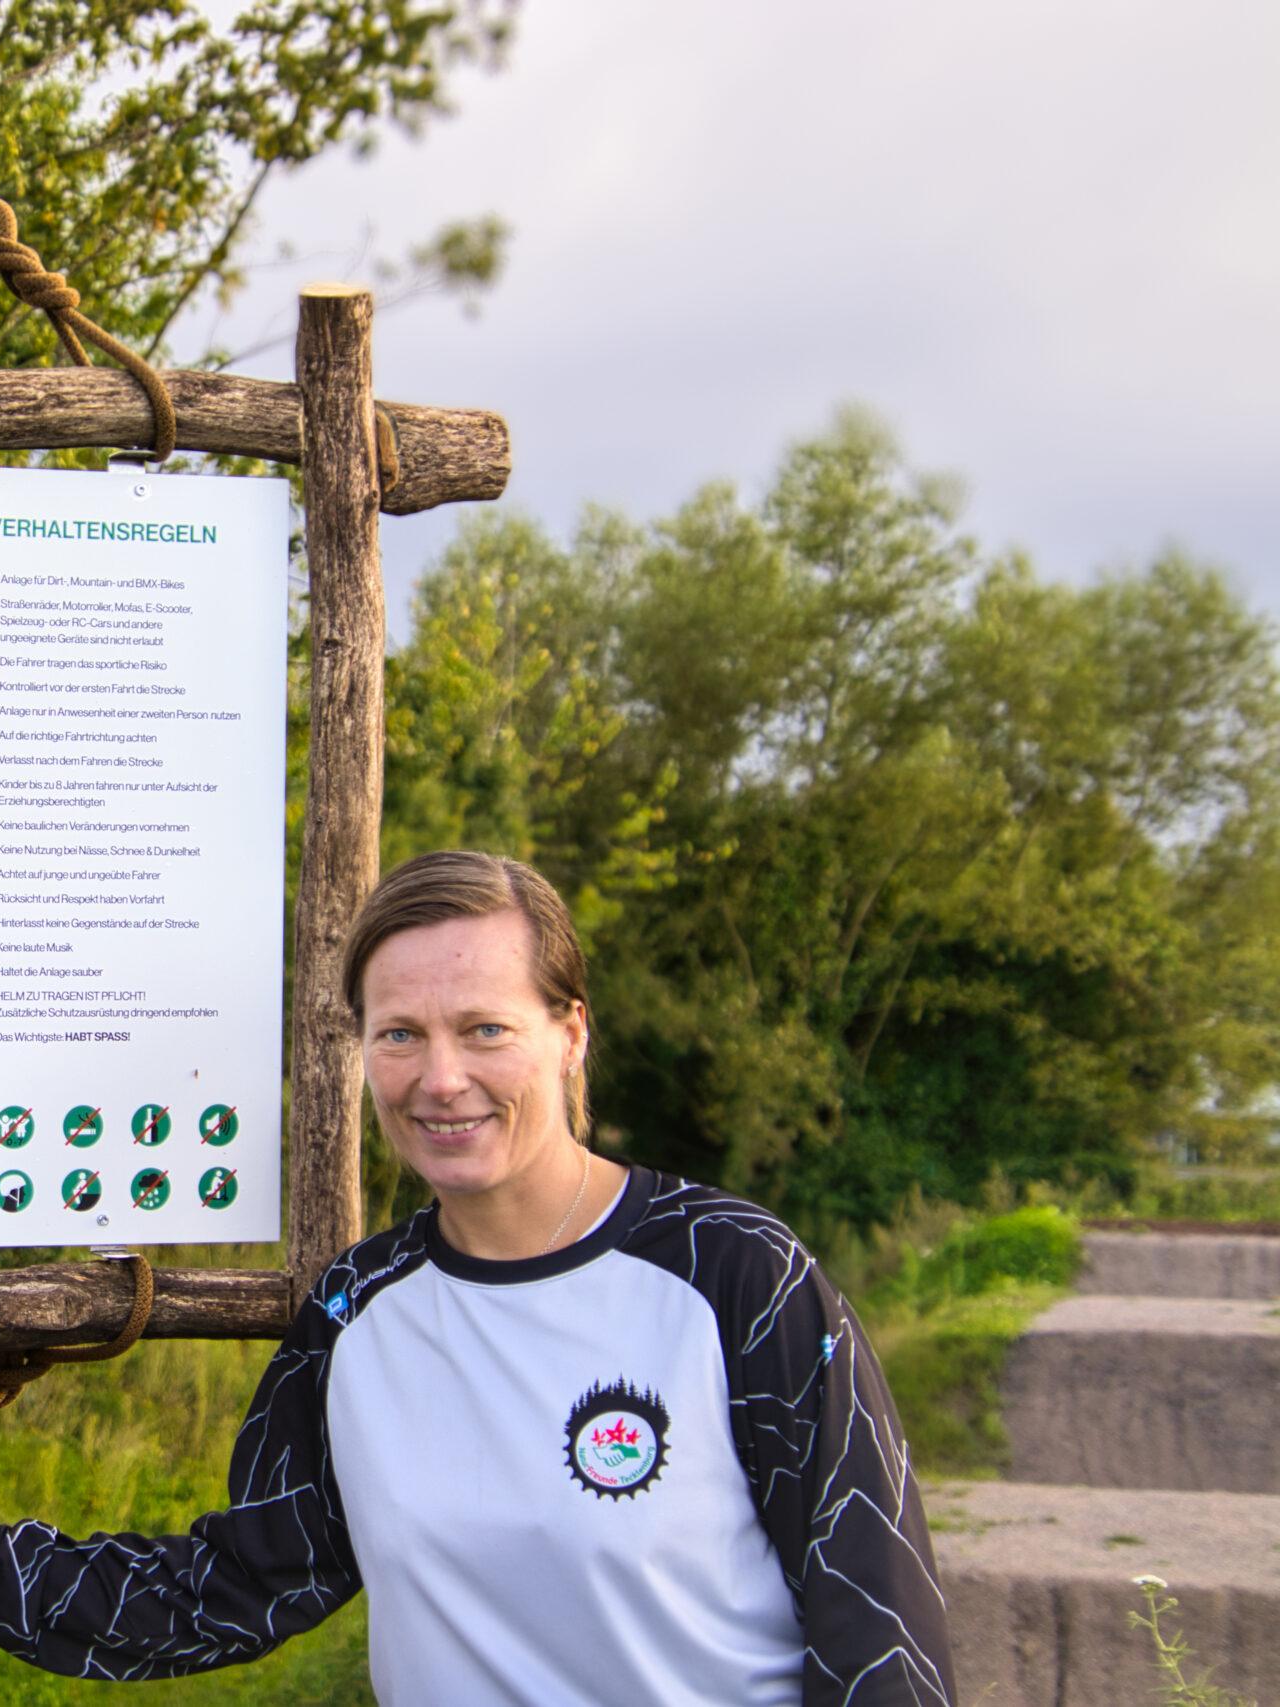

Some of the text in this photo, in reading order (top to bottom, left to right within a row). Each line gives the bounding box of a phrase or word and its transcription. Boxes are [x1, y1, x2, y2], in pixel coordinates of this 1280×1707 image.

[1, 573, 32, 588] Anlage
[34, 574, 46, 586] für
[70, 576, 115, 588] Mountain-
[117, 577, 134, 589] und
[136, 577, 185, 591] BMX-Bikes
[0, 598, 193, 616] Straßenräder, Motorroller, Mofas, E-Scooter,
[0, 614, 162, 630] Spielzeug- oder RC-Cars und andere
[0, 632, 163, 647] ungeeignete Geräte sind nicht erlaubt
[0, 656, 167, 672] Die Fahrer tragen das sportliche Risiko
[0, 680, 186, 696] Kontrolliert der ersten Fahrt die Strecke
[0, 705, 240, 721] Anlage Anwesenheit einer zweiten Person nutzen
[0, 729, 157, 745] Auf die richtige Fahrtrichtung achten
[0, 754, 163, 768] Verlasst nach dem Fahren die Strecke
[0, 778, 27, 790] Kinder
[30, 779, 43, 790] bis
[63, 779, 94, 791] Jahren
[96, 780, 124, 792] fahren
[125, 783, 140, 792] nur
[141, 781, 164, 792] unter
[166, 781, 201, 793] Aufsicht
[203, 782, 217, 793] der
[25, 820, 67, 832] baulichen
[69, 820, 138, 834] Veränderungen
[140, 822, 189, 833] vornehmen
[25, 844, 62, 857] Nutzung
[64, 845, 77, 856] bei
[79, 845, 109, 857] Nässe,
[111, 845, 144, 857] Schnee
[154, 845, 200, 857] Dunkelheit
[28, 869, 43, 880] auf
[43, 869, 68, 882] junge
[70, 869, 87, 880] und
[89, 869, 130, 882] ungeübte
[132, 869, 160, 881] Fahrer
[43, 893, 60, 904] und
[61, 893, 98, 906] Respekt
[100, 893, 127, 905] haben
[129, 894, 164, 905] Vorfahrt
[46, 918, 69, 929] keine
[71, 917, 132, 931] Gegenstände
[133, 918, 148, 929] auf
[149, 918, 163, 929] der
[165, 918, 199, 929] Strecke
[23, 942, 45, 953] laute
[47, 942, 73, 953] Musik
[25, 966, 38, 977] die
[39, 966, 70, 979] Anlage
[72, 966, 103, 977] sauber
[26, 990, 40, 1002] ZU
[42, 990, 83, 1002] TRAGEN
[85, 990, 99, 1002] IST
[102, 990, 145, 1002] PFLICHT!
[48, 1007, 129, 1020] Schutzausrüstung
[131, 1007, 169, 1020] dringend
[171, 1007, 218, 1020] empfohlen
[65, 1031, 92, 1042] HABT
[94, 1031, 130, 1042] SPASS!
